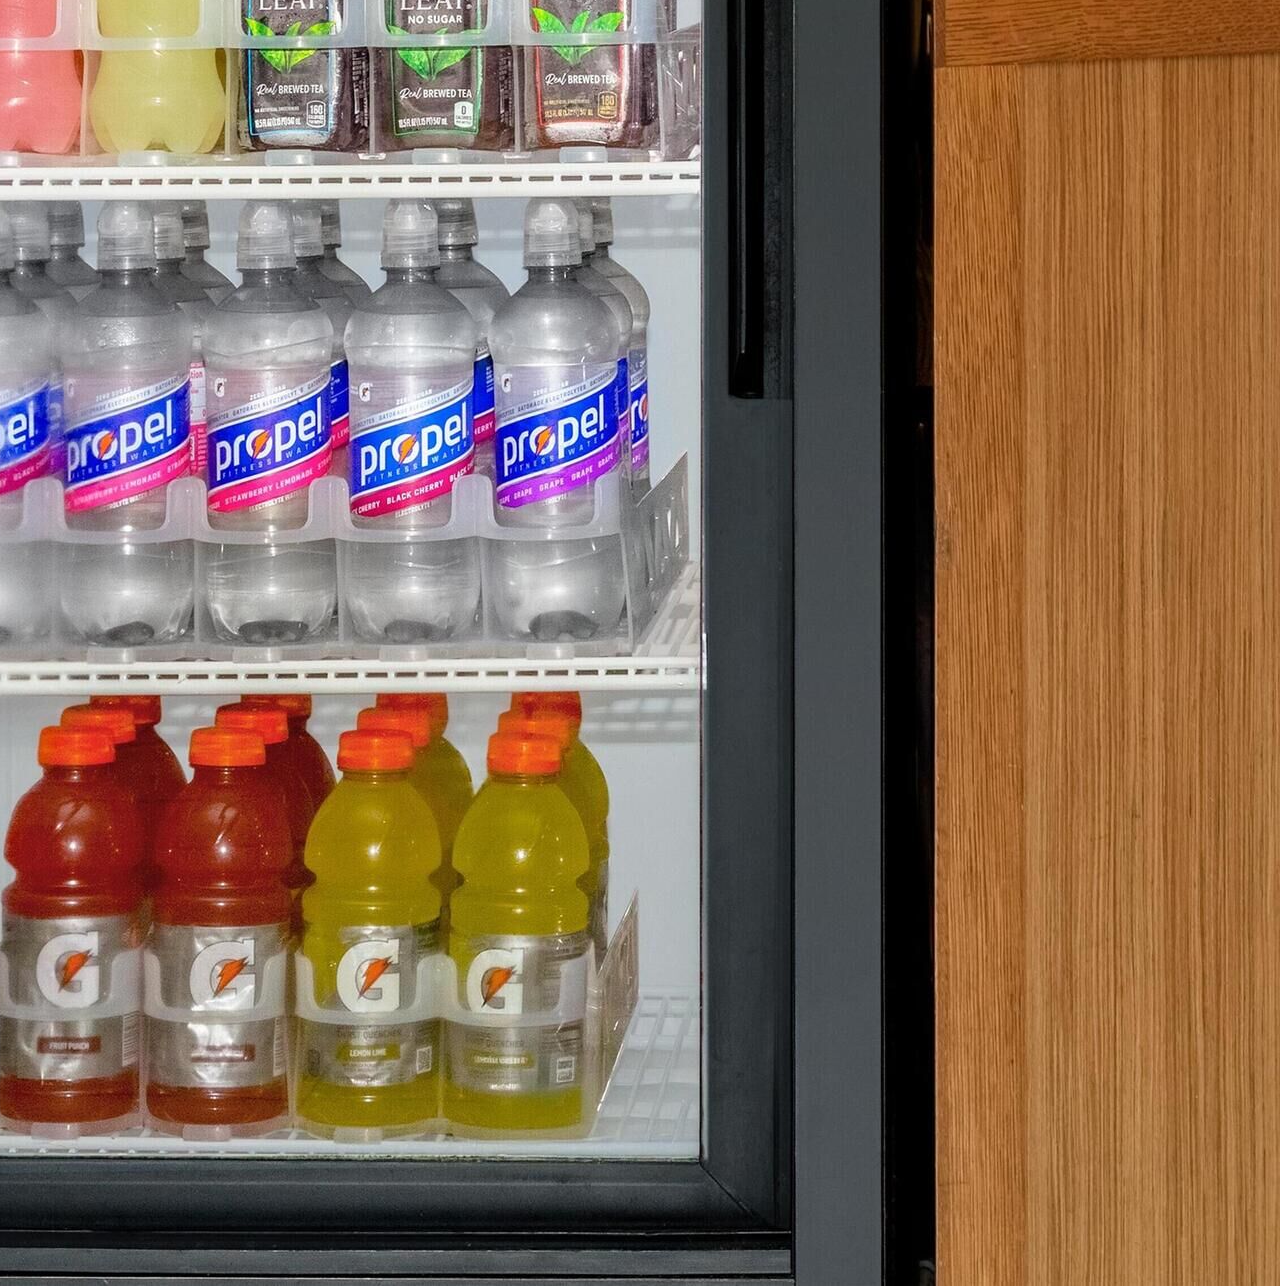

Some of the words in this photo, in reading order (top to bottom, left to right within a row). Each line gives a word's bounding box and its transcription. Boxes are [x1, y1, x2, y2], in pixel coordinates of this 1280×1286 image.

[408, 14, 424, 24] NO
[427, 14, 463, 24] SUGAR
[278, 84, 310, 95] BREWED
[310, 83, 324, 94] TEA
[422, 88, 457, 98] BREWED
[458, 88, 472, 98] TEA
[567, 74, 600, 84] BREWED
[67, 399, 172, 482] propel
[216, 396, 322, 481] propel
[360, 401, 467, 487] propel
[503, 394, 605, 477] propel
[120, 472, 161, 491] LEMONADE
[224, 484, 273, 505] STRAWBERRY
[275, 468, 314, 490] LEMONADE
[358, 500, 381, 514] CHERRY
[386, 491, 412, 505] BLACK
[414, 480, 444, 497] CHERRY
[513, 487, 533, 500] GRAPE
[539, 477, 565, 492] GRAPE
[571, 466, 594, 481] GRAPE
[598, 453, 614, 468] GRAPE
[35, 931, 99, 1008] G
[336, 938, 401, 1014] G
[466, 948, 524, 1014] G
[349, 1048, 371, 1057] LEMON
